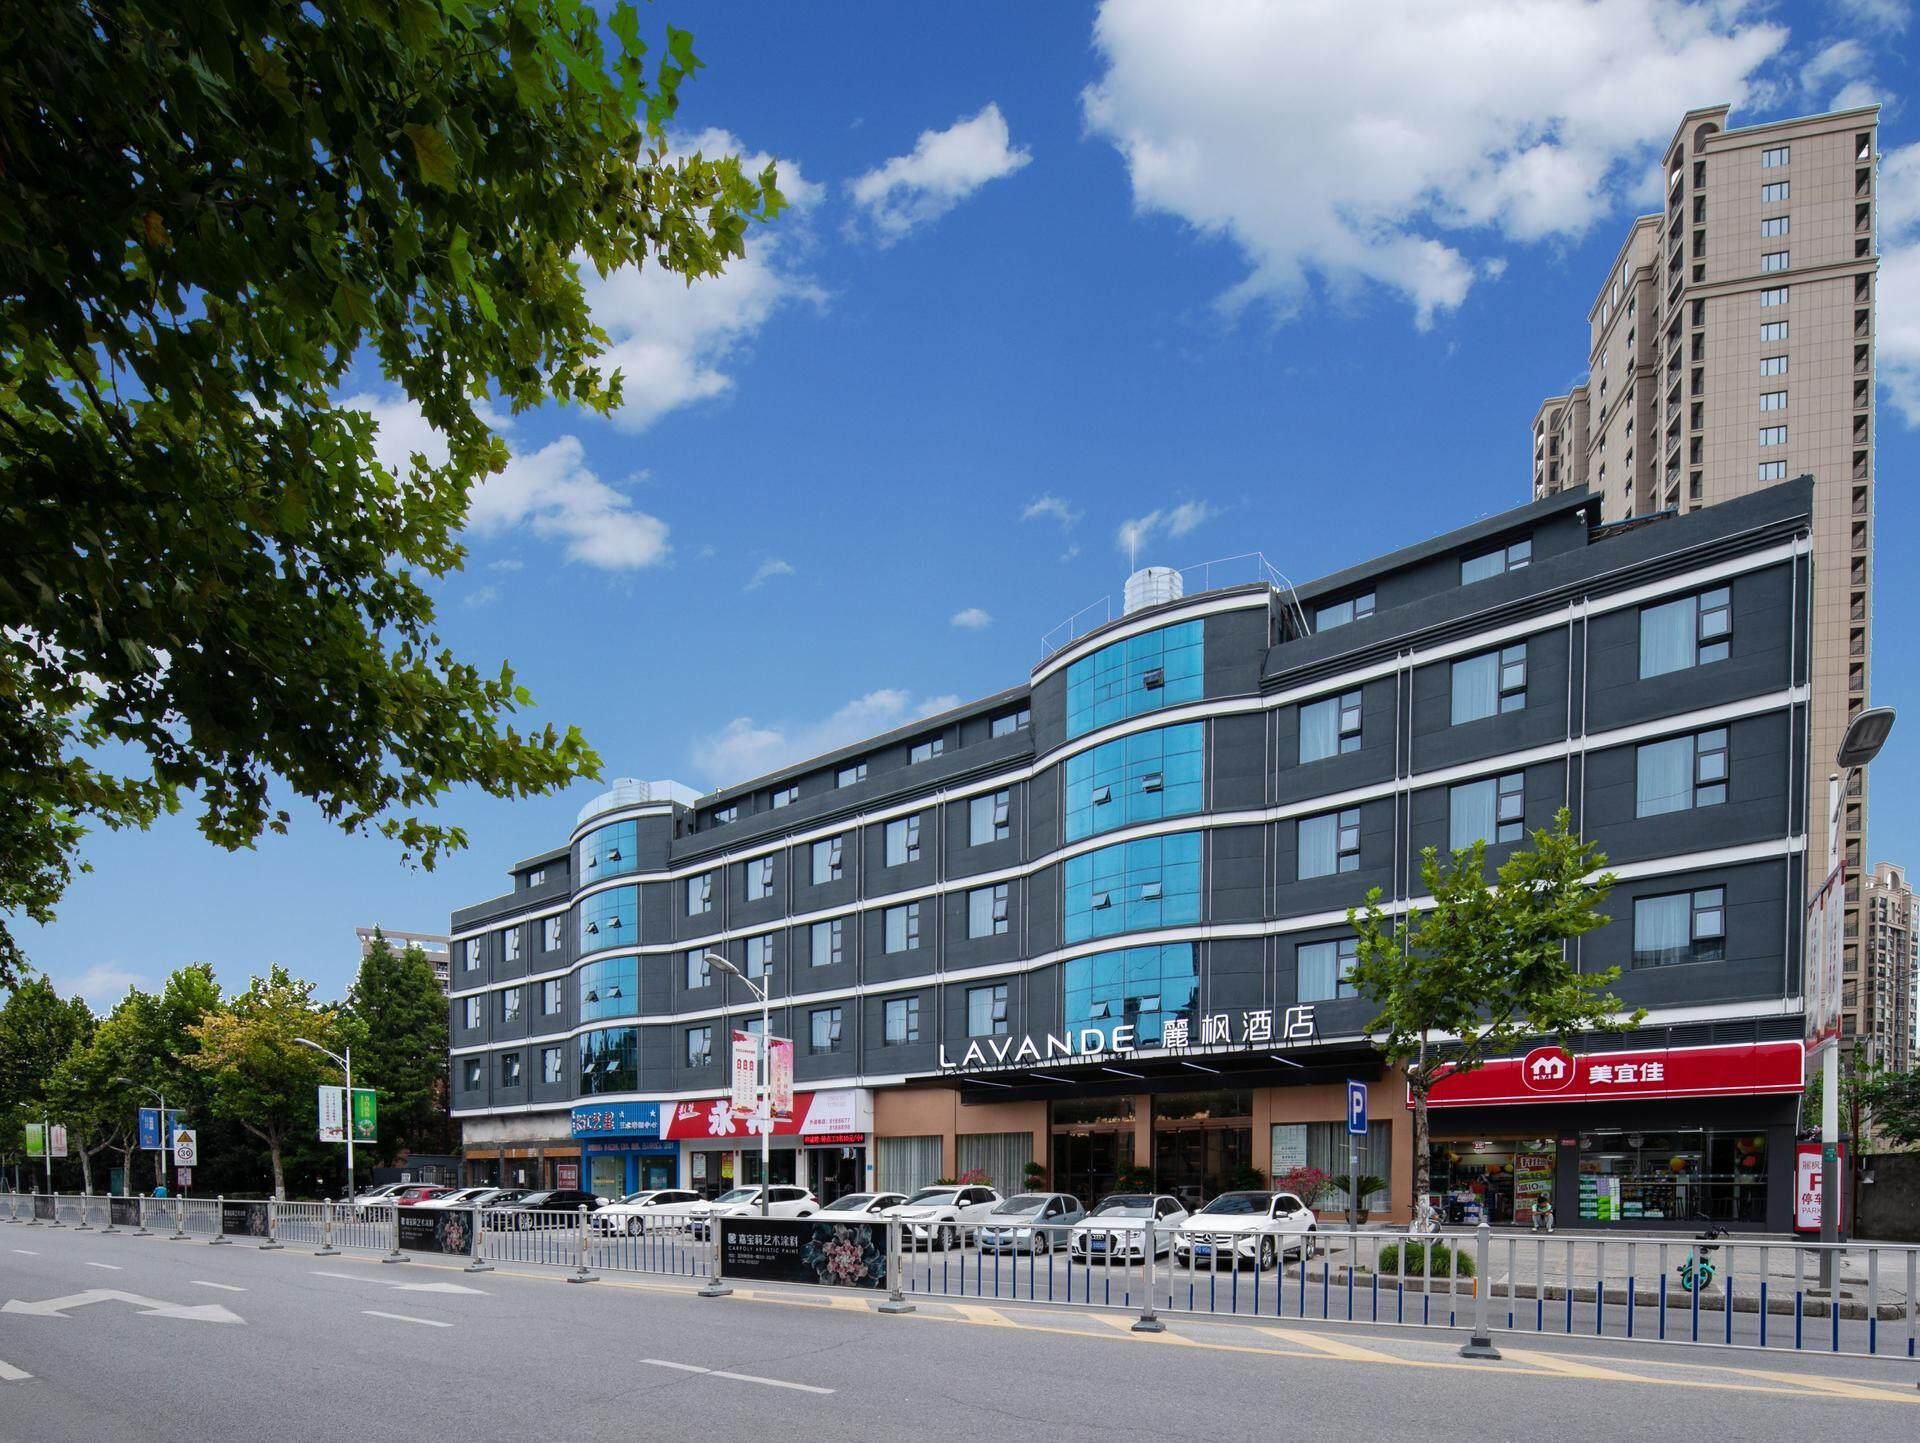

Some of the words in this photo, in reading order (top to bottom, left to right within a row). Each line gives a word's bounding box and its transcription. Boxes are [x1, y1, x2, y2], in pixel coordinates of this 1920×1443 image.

[1162, 1004, 1315, 1049] 麗枫酒店
[939, 1023, 1135, 1068] LAVANDE
[1588, 1061, 1665, 1085] 美宜佳
[1352, 1090, 1364, 1125] P
[180, 1149, 191, 1157] 30
[1802, 1193, 1822, 1205] 停车
